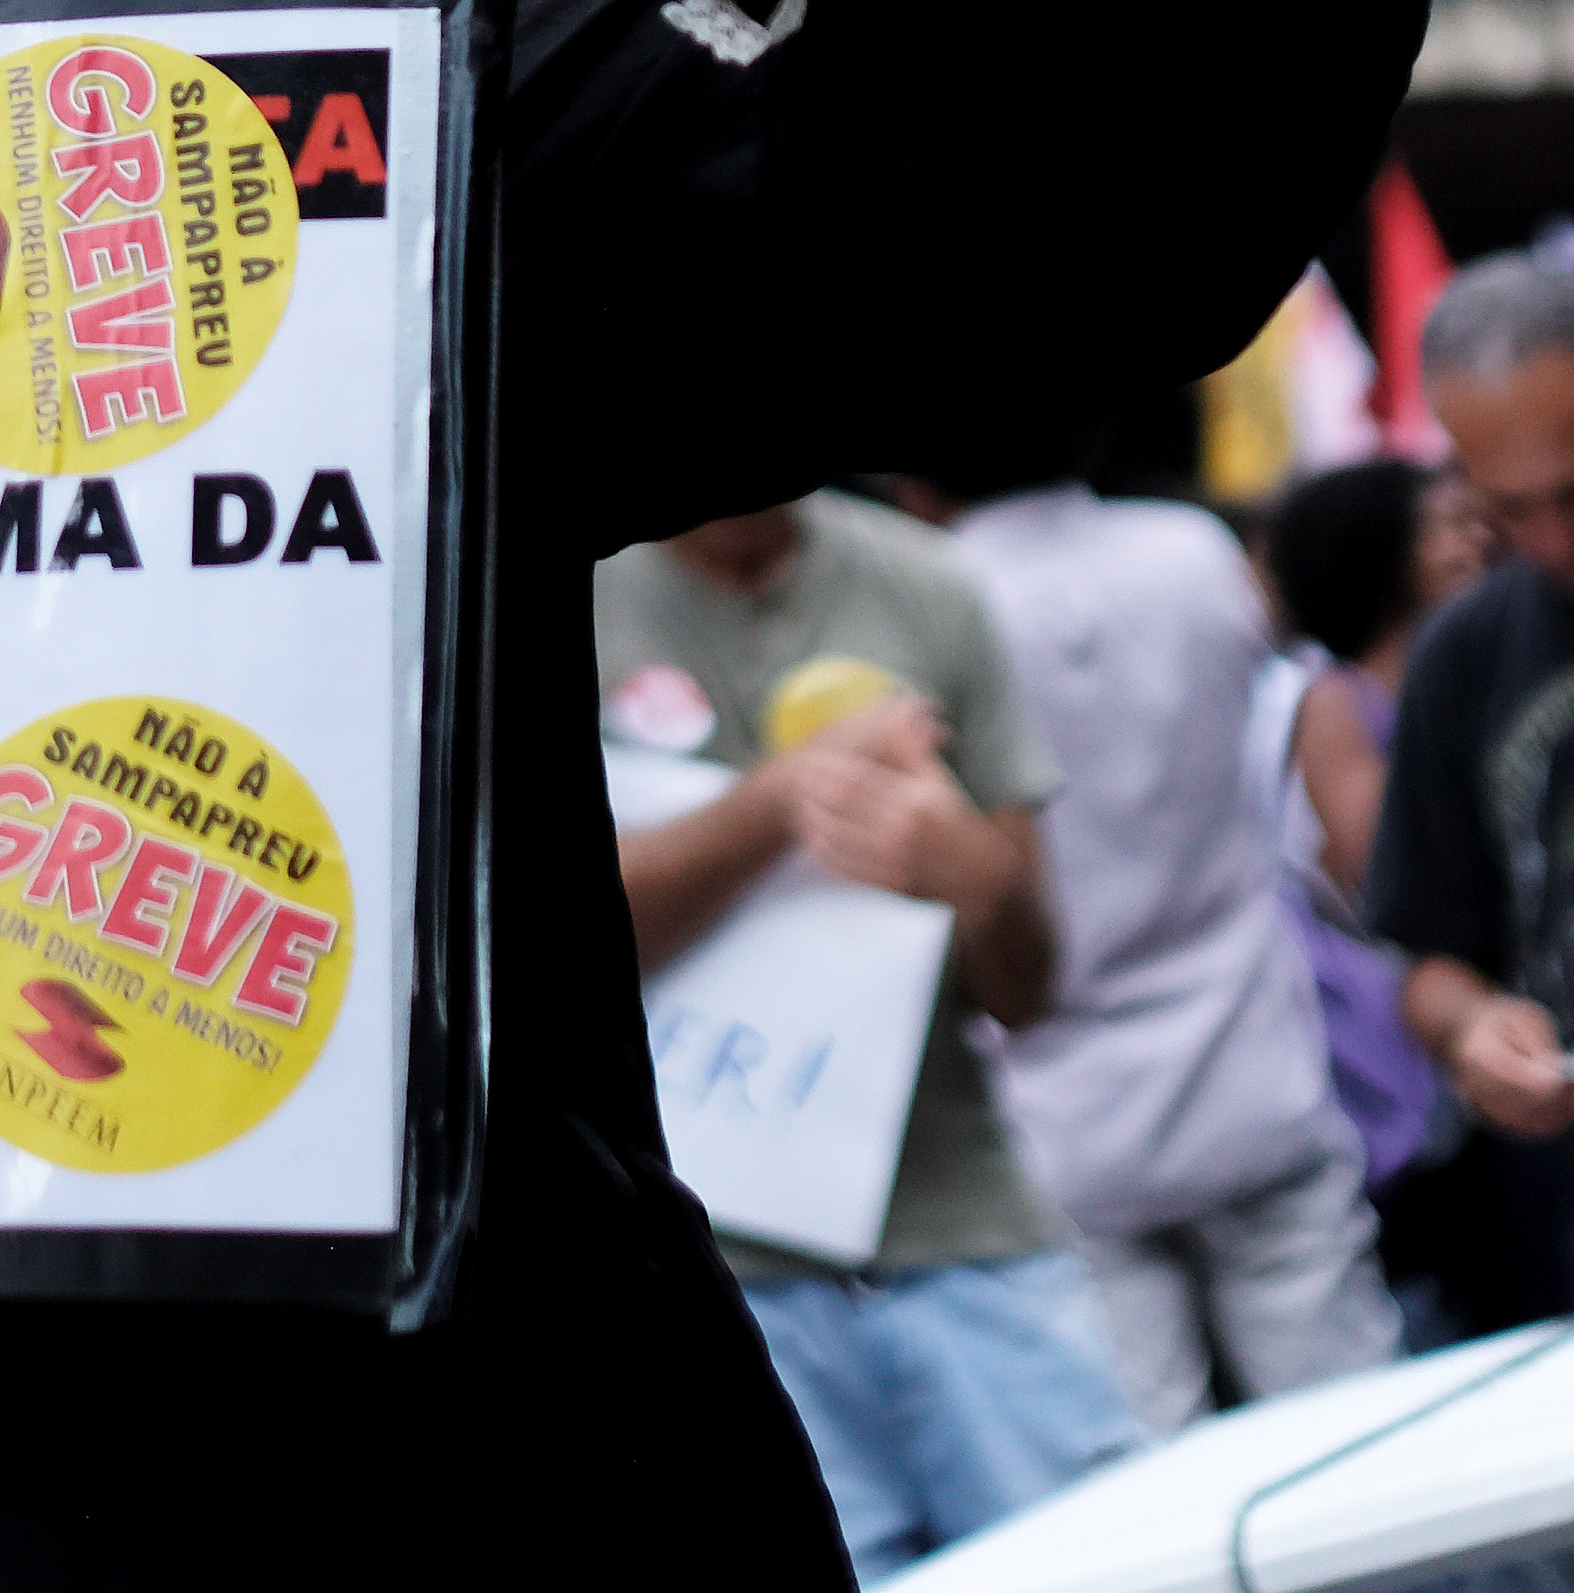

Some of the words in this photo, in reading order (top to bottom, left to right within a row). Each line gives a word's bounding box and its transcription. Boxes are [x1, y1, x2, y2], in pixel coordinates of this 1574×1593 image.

[7, 65, 40, 187] NENHUM
[16, 194, 51, 300] DIREITO
[46, 45, 188, 440] GREVE
[27, 310, 53, 329] A
[191, 468, 382, 567] DA
[43, 931, 147, 1003] DIREITO
[147, 986, 171, 1018] A
